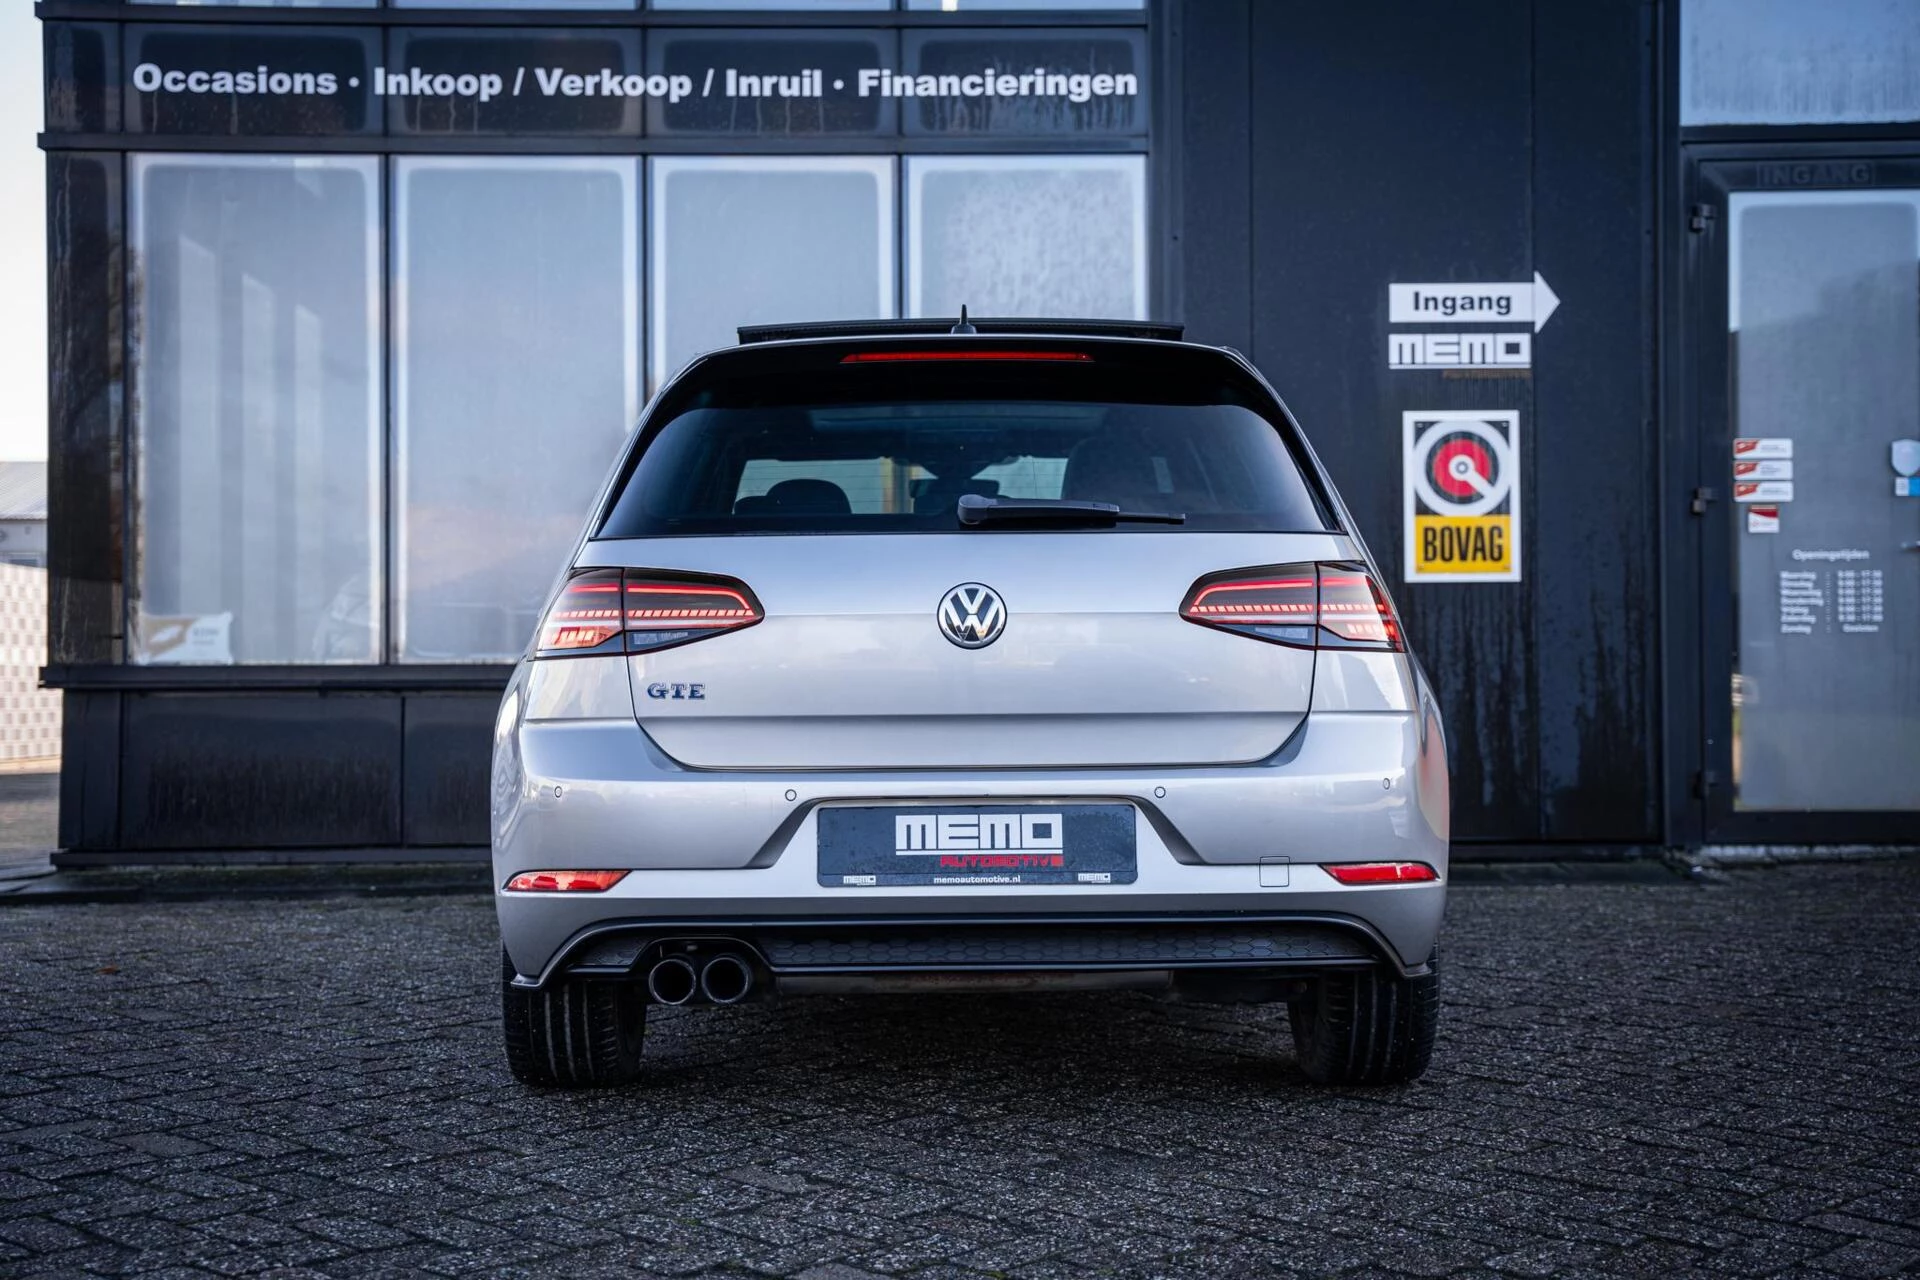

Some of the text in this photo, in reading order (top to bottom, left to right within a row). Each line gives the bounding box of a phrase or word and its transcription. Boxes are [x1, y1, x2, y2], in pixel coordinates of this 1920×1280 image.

[134, 63, 338, 95] Occasions
[374, 67, 503, 102] Inkoop
[535, 67, 693, 103] Verkoop
[725, 68, 823, 98] Inruil
[858, 68, 1138, 103] Financieringen
[1413, 291, 1511, 315] Ingang
[1389, 333, 1531, 364] MEMO
[1423, 526, 1503, 562] BOVAG
[647, 682, 705, 699] GTE
[895, 814, 1063, 851] MEMO
[933, 875, 1021, 885] memoautomotive.nl
